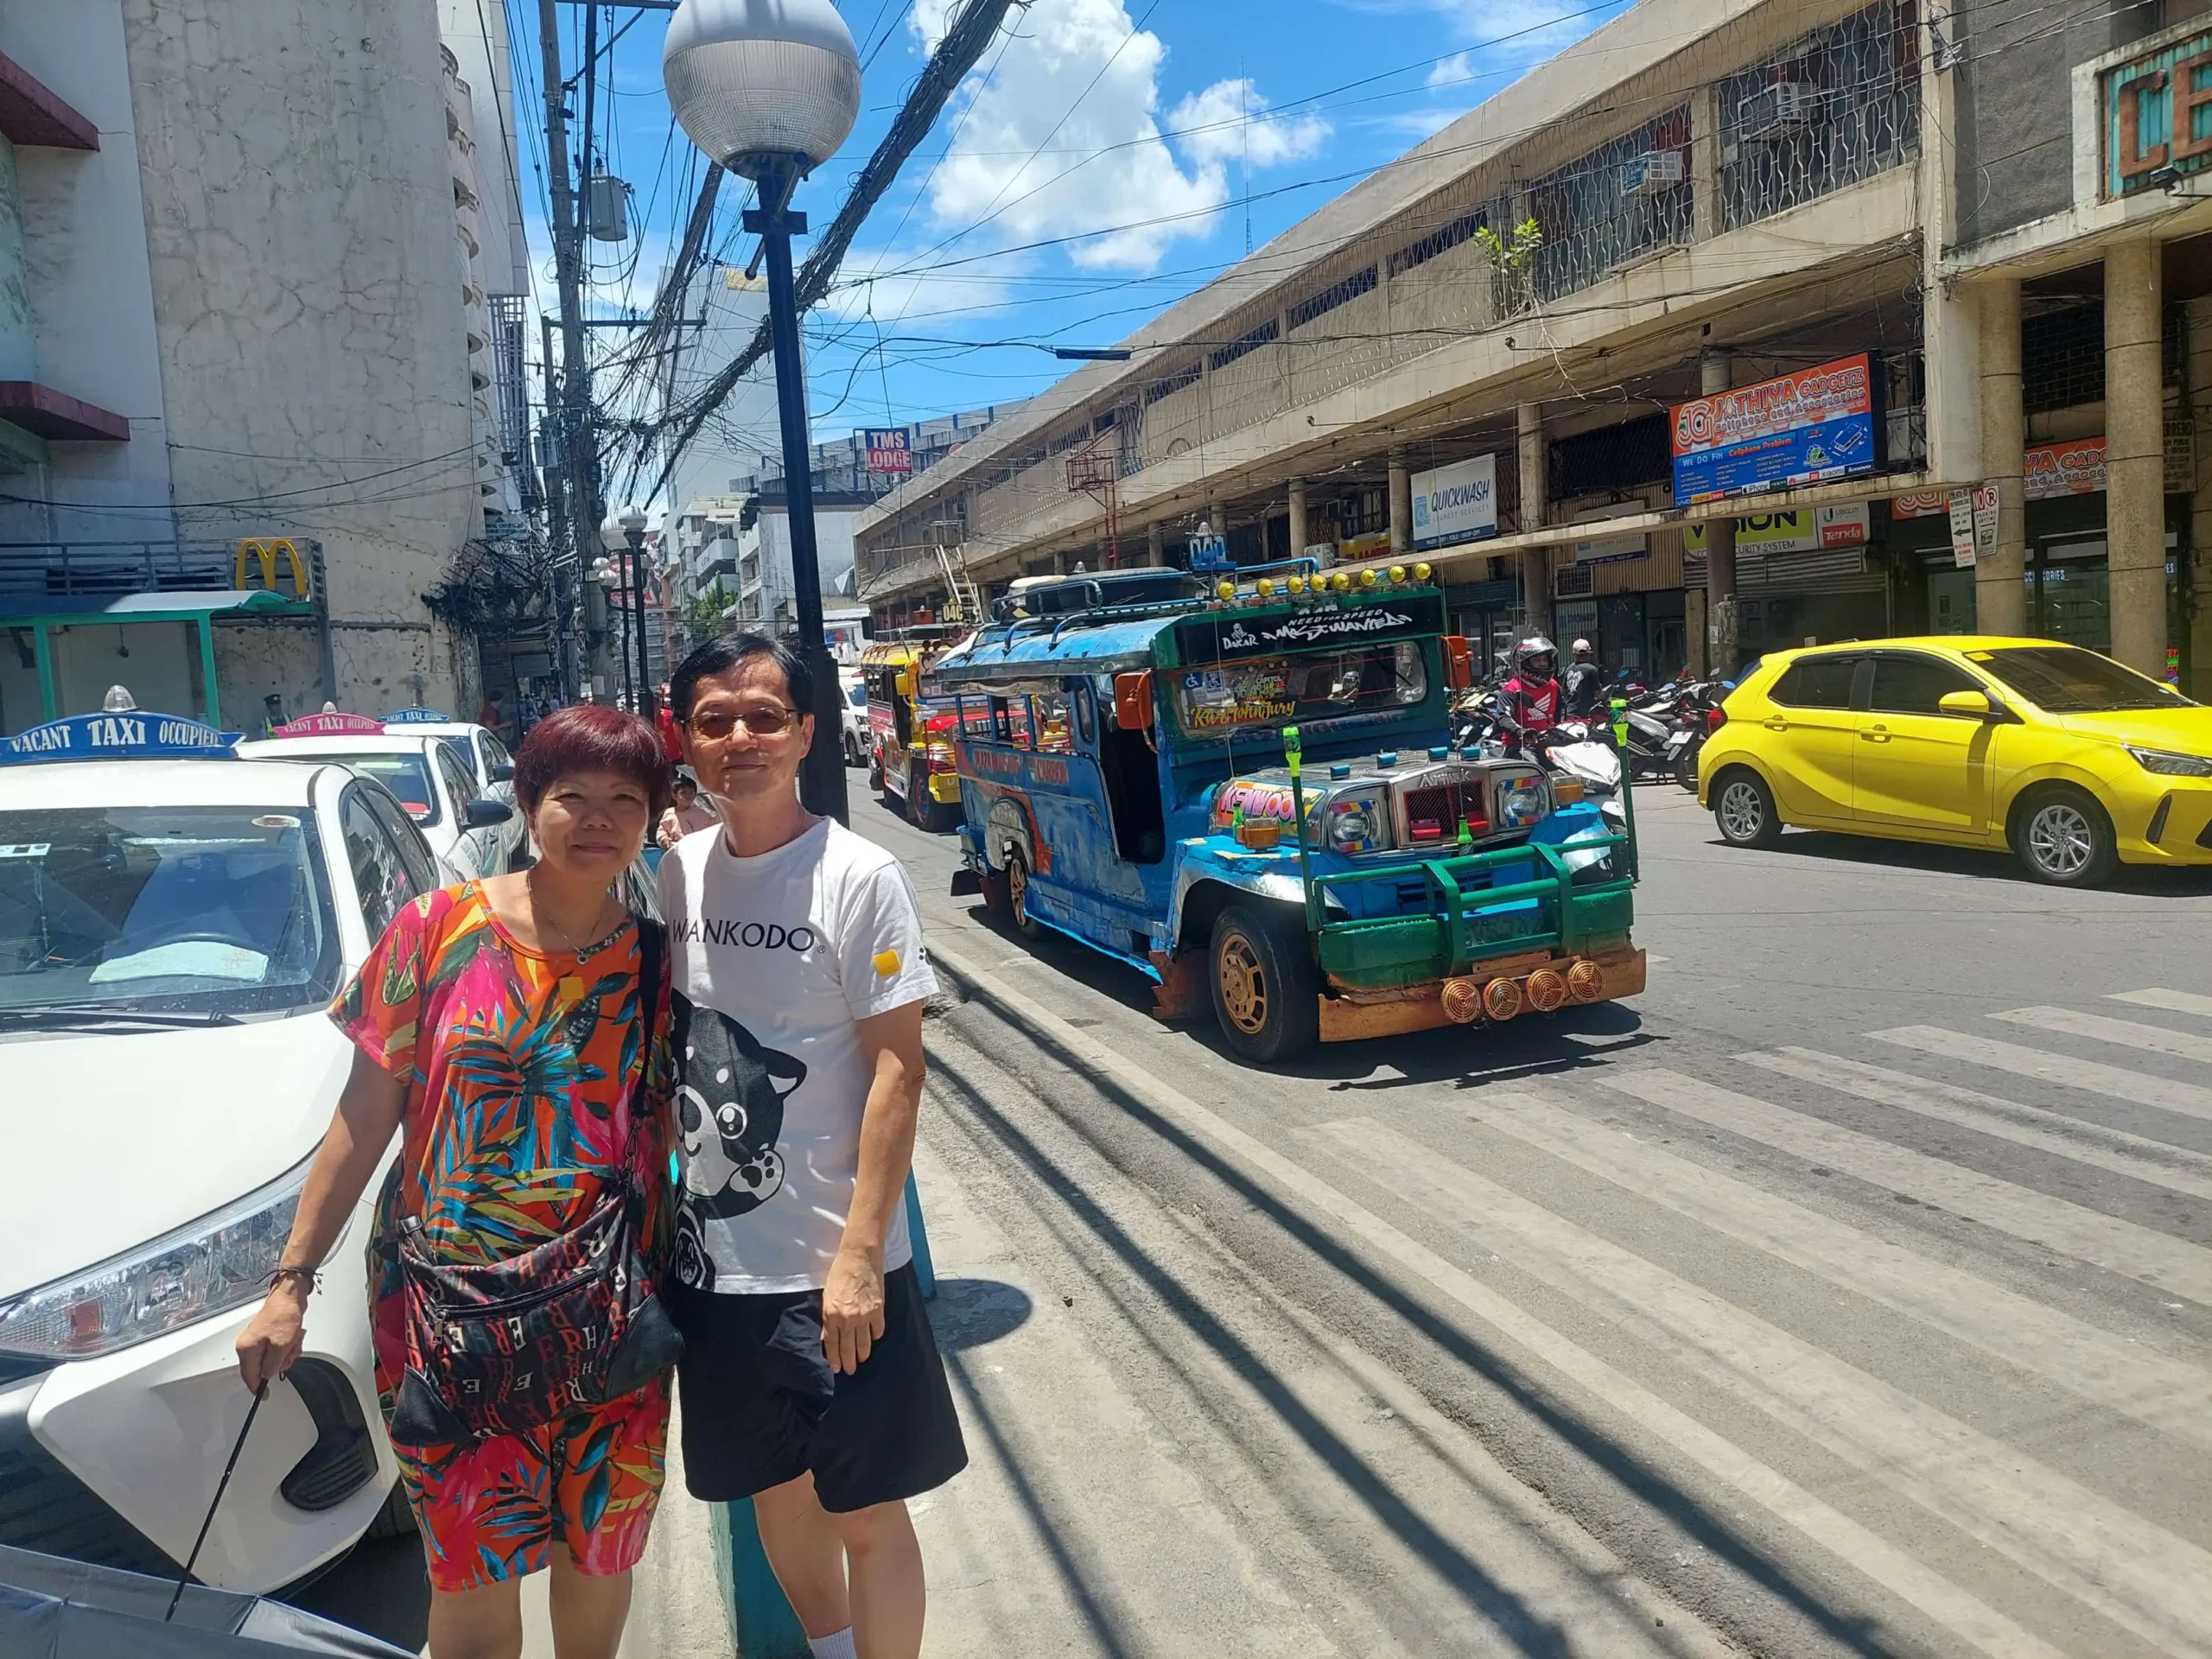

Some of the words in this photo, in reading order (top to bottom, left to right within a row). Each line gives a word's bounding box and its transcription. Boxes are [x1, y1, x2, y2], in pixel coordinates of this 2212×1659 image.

[1799, 366, 1865, 398] GADGETZ
[870, 431, 905, 449] TMS
[1763, 436, 1792, 448] Problem
[867, 449, 911, 472] LODGE
[1682, 458, 1694, 467] WE
[1696, 454, 1708, 465] DO
[1431, 479, 1491, 512] QUICKWASH
[1974, 489, 1986, 512] NO
[1460, 504, 1491, 517] SERVICES
[1824, 527, 1860, 542] Tenda
[1764, 540, 1796, 551] SYSTEM
[1287, 616, 1321, 626] NEED
[1342, 608, 1383, 620] SPEED
[284, 719, 312, 734] VACANT
[317, 717, 344, 730] TAXI
[347, 718, 375, 730] OCCUPIED
[10, 725, 72, 754] VACANT
[87, 718, 147, 747] TAXI
[671, 918, 815, 952] WANKODO
